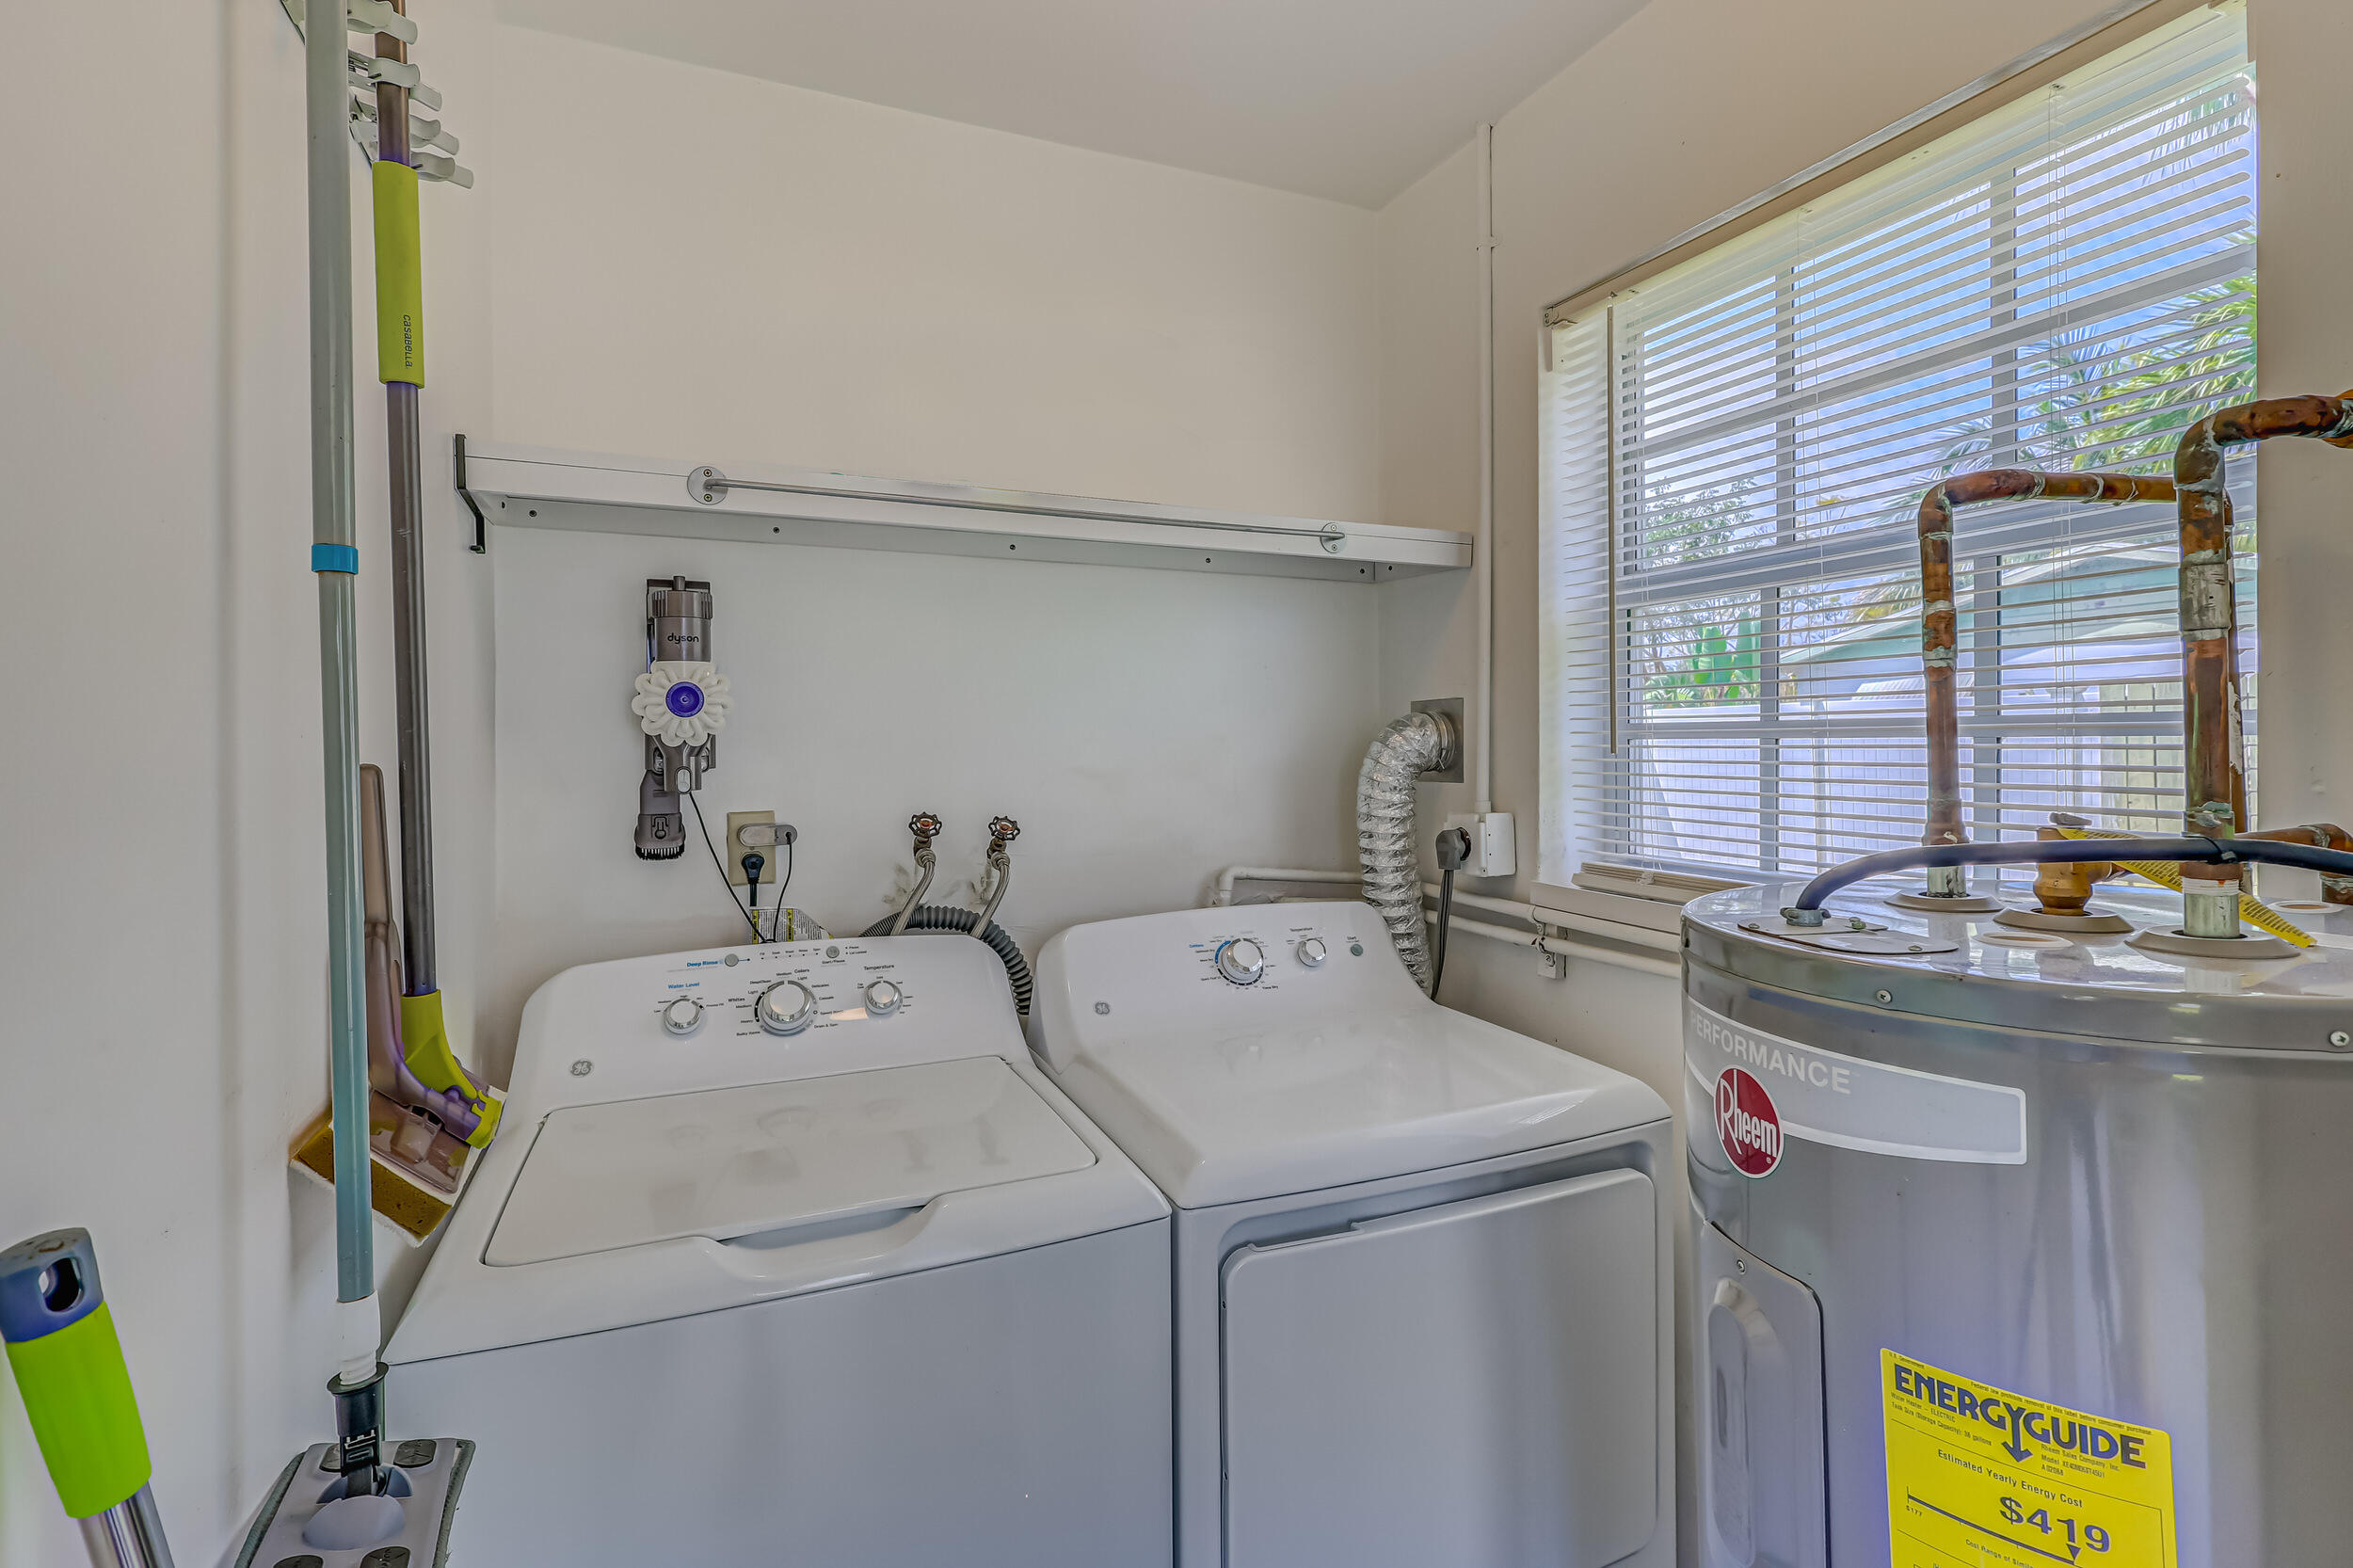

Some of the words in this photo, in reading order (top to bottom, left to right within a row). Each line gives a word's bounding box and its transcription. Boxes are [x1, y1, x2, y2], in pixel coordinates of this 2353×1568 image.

[666, 632, 699, 645] dyson
[1690, 1010, 1852, 1096] PERFORMANCE
[1720, 1068, 1778, 1159] Rheem
[1892, 1401, 1903, 1411] Tank
[1930, 1408, 1956, 1423] ELECTRIC
[2041, 1454, 2059, 1465] Model
[2062, 1449, 2077, 1461] Sales
[1938, 1448, 1983, 1474] Estimated
[1986, 1468, 2017, 1487] Yearly
[2021, 1480, 2057, 1500] Energy
[2059, 1494, 2083, 1508] Cost
[1999, 1496, 2110, 1553] $419
[1965, 1538, 1980, 1550] Cost
[1981, 1545, 2003, 1560] Range
[2004, 1555, 2011, 1563] of
